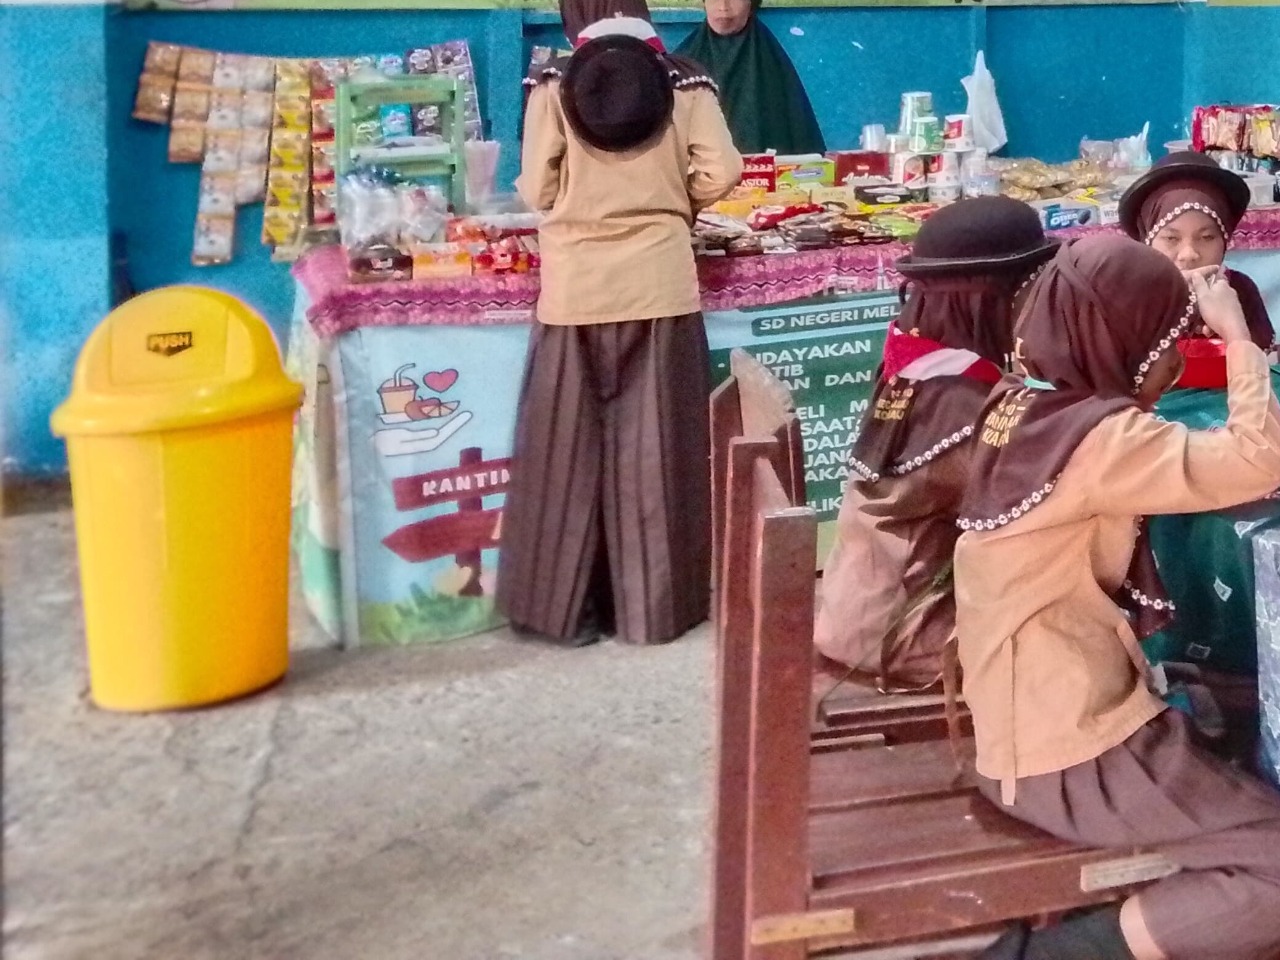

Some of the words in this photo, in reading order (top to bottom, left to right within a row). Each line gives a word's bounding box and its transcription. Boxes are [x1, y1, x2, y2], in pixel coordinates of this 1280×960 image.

[760, 318, 785, 330] SD
[790, 310, 859, 327] NEGERI
[863, 305, 901, 319] MEL
[825, 370, 872, 386] DAN
[804, 431, 858, 452] DALA
